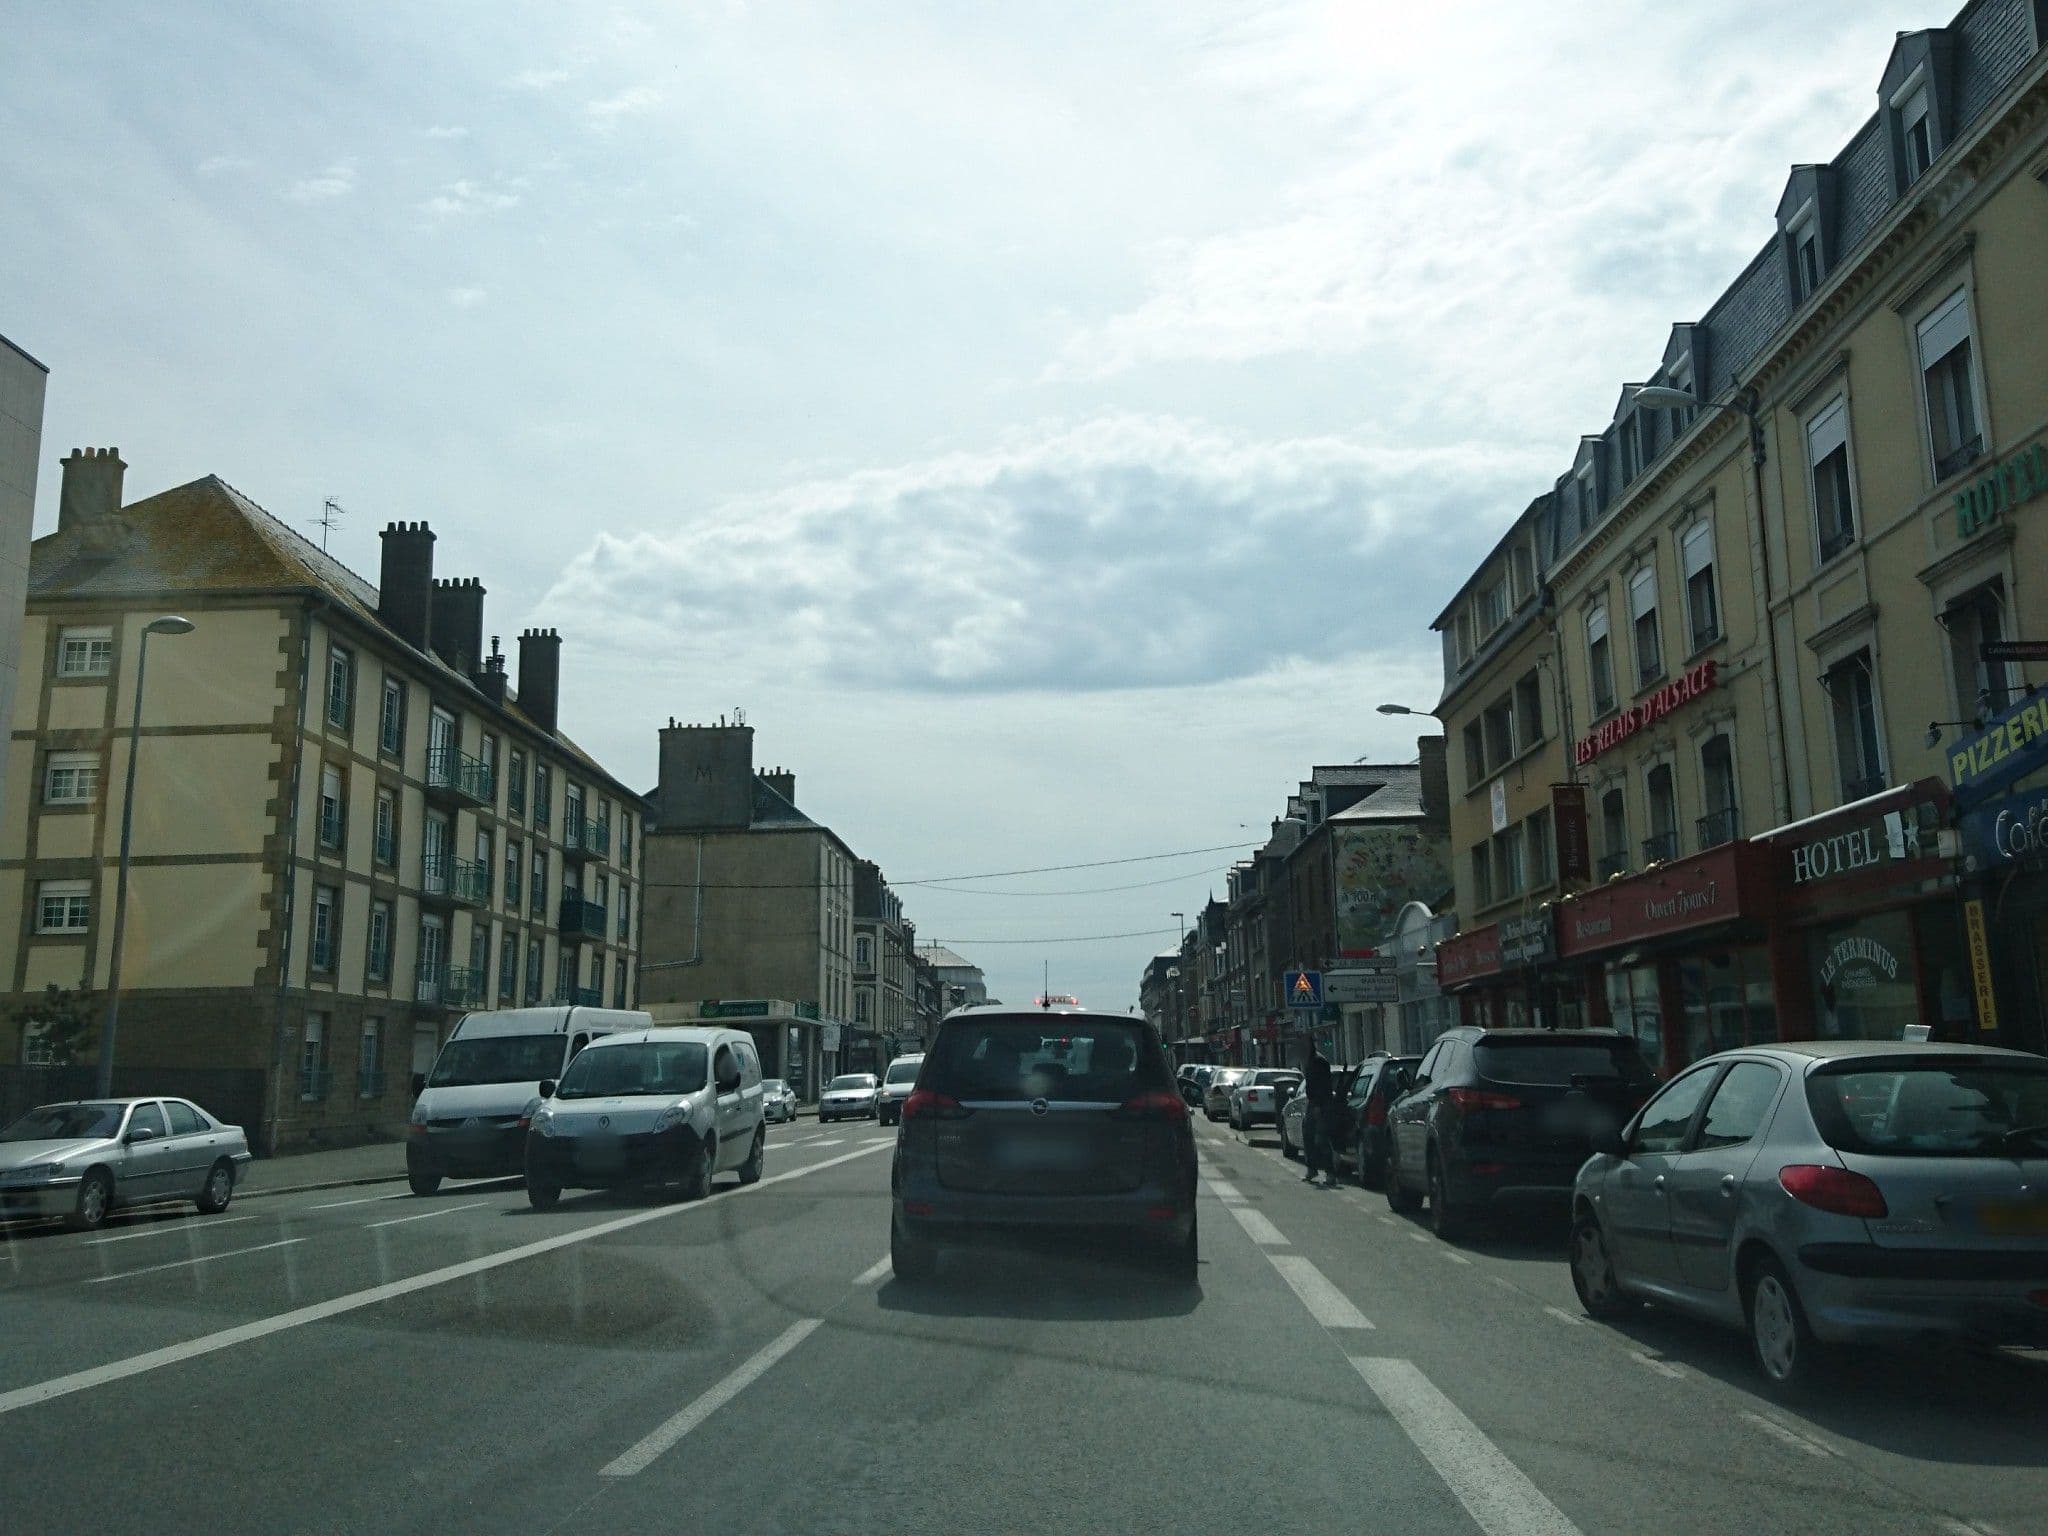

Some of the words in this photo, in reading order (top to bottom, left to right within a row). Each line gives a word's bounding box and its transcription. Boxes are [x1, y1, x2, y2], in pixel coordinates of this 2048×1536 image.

[1953, 442, 2048, 538] HOTEL
[1599, 710, 1637, 752] RELAIS
[1643, 660, 1709, 724] D'ALSACE
[1791, 827, 1880, 883] HOTEL
[1833, 936, 1898, 979] TERMINUS
[1968, 905, 1991, 1024] BRASSERIE
